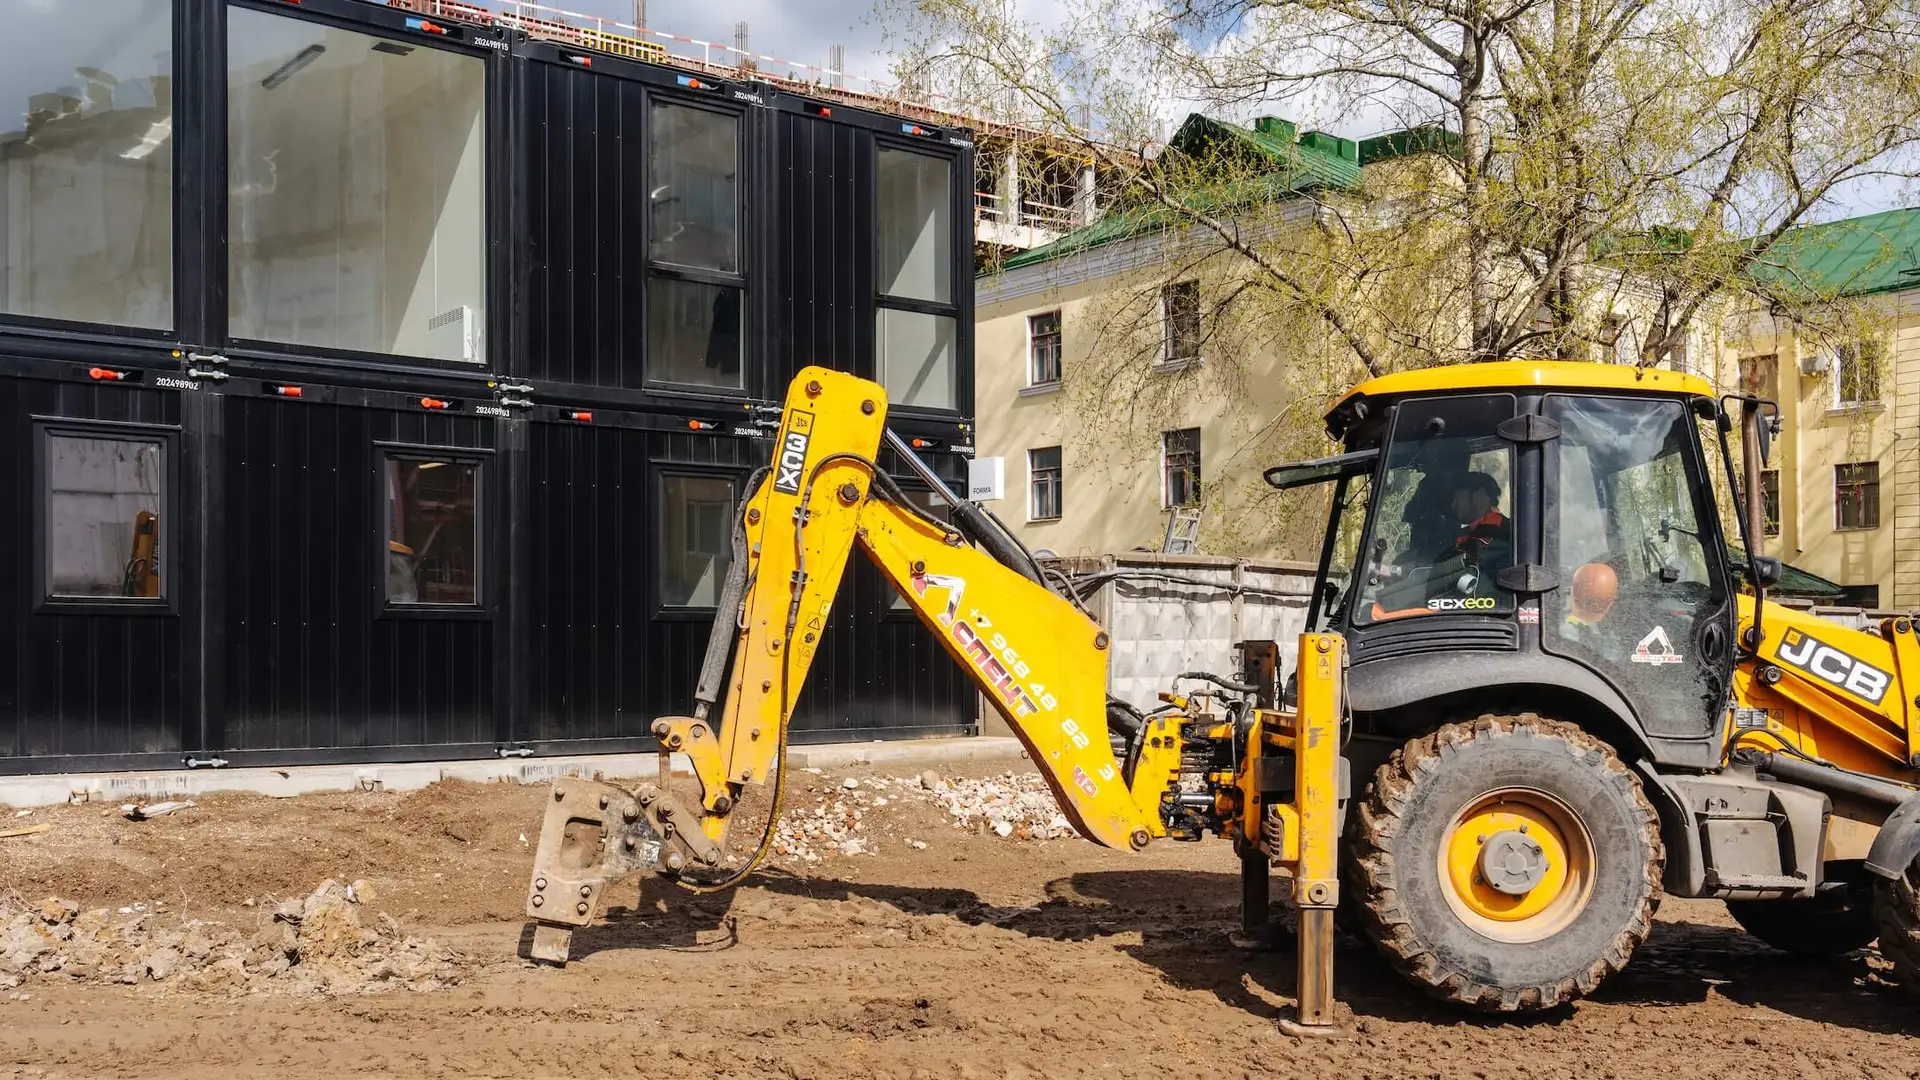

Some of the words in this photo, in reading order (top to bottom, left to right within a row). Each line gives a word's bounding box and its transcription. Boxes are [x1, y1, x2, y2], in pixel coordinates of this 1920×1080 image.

[474, 37, 509, 51] 202498915
[156, 377, 199, 391] 202498902
[475, 405, 510, 417] 202498903
[776, 433, 807, 488] 3CX
[1780, 638, 1888, 701] JCB
[990, 632, 1031, 679] 968
[1028, 682, 1057, 711] 48
[1061, 717, 1090, 749] 82
